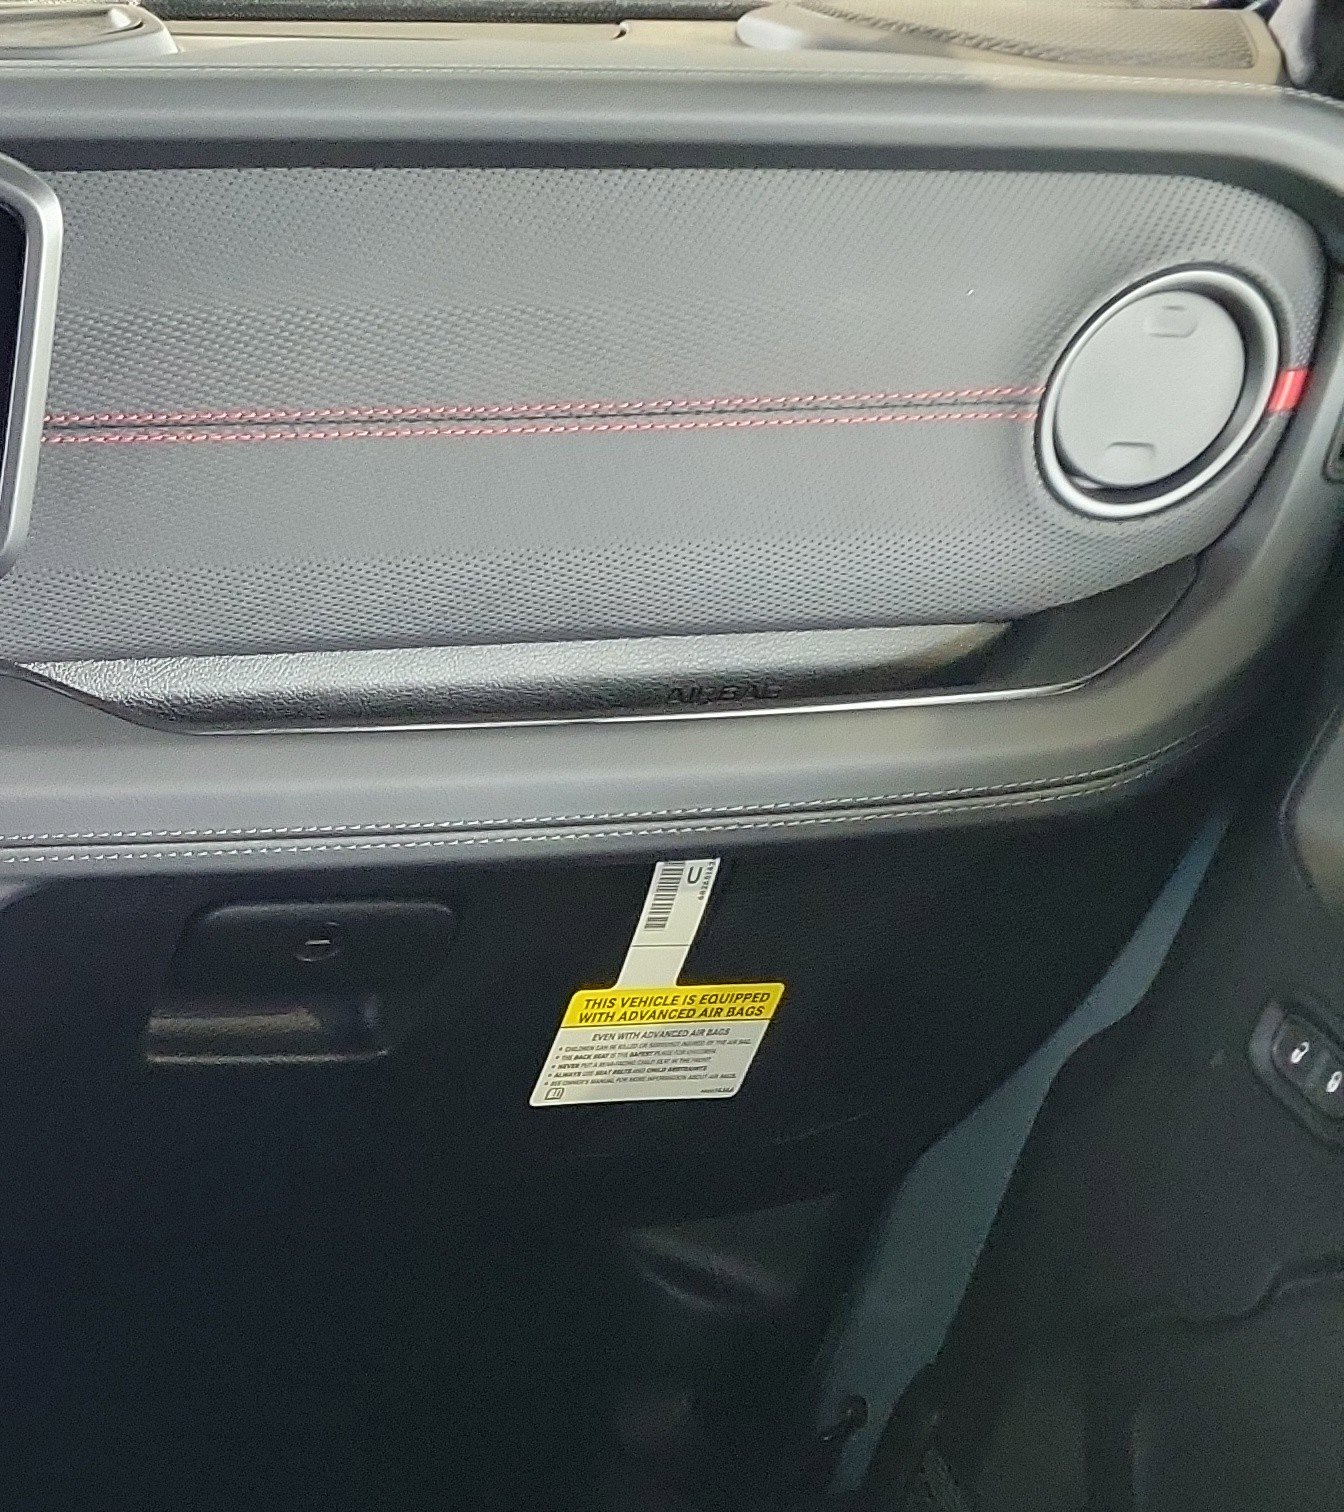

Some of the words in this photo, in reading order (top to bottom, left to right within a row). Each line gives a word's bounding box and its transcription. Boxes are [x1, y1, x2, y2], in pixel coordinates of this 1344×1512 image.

[688, 866, 703, 884] U
[584, 997, 617, 1010] THIS
[620, 995, 680, 1008] VEHICLE
[681, 994, 697, 1006] IS
[699, 992, 770, 1005] EQUIPPED
[579, 1011, 616, 1024] WITH
[617, 1008, 696, 1021] ADVANCED
[698, 1007, 723, 1018] AIR
[725, 1005, 765, 1017] BAGS
[592, 1032, 615, 1041] EVEN
[617, 1031, 640, 1040] WITH
[640, 1029, 688, 1039] ADVANCED
[689, 1028, 705, 1037] AIR
[706, 1027, 730, 1036] BAGS
